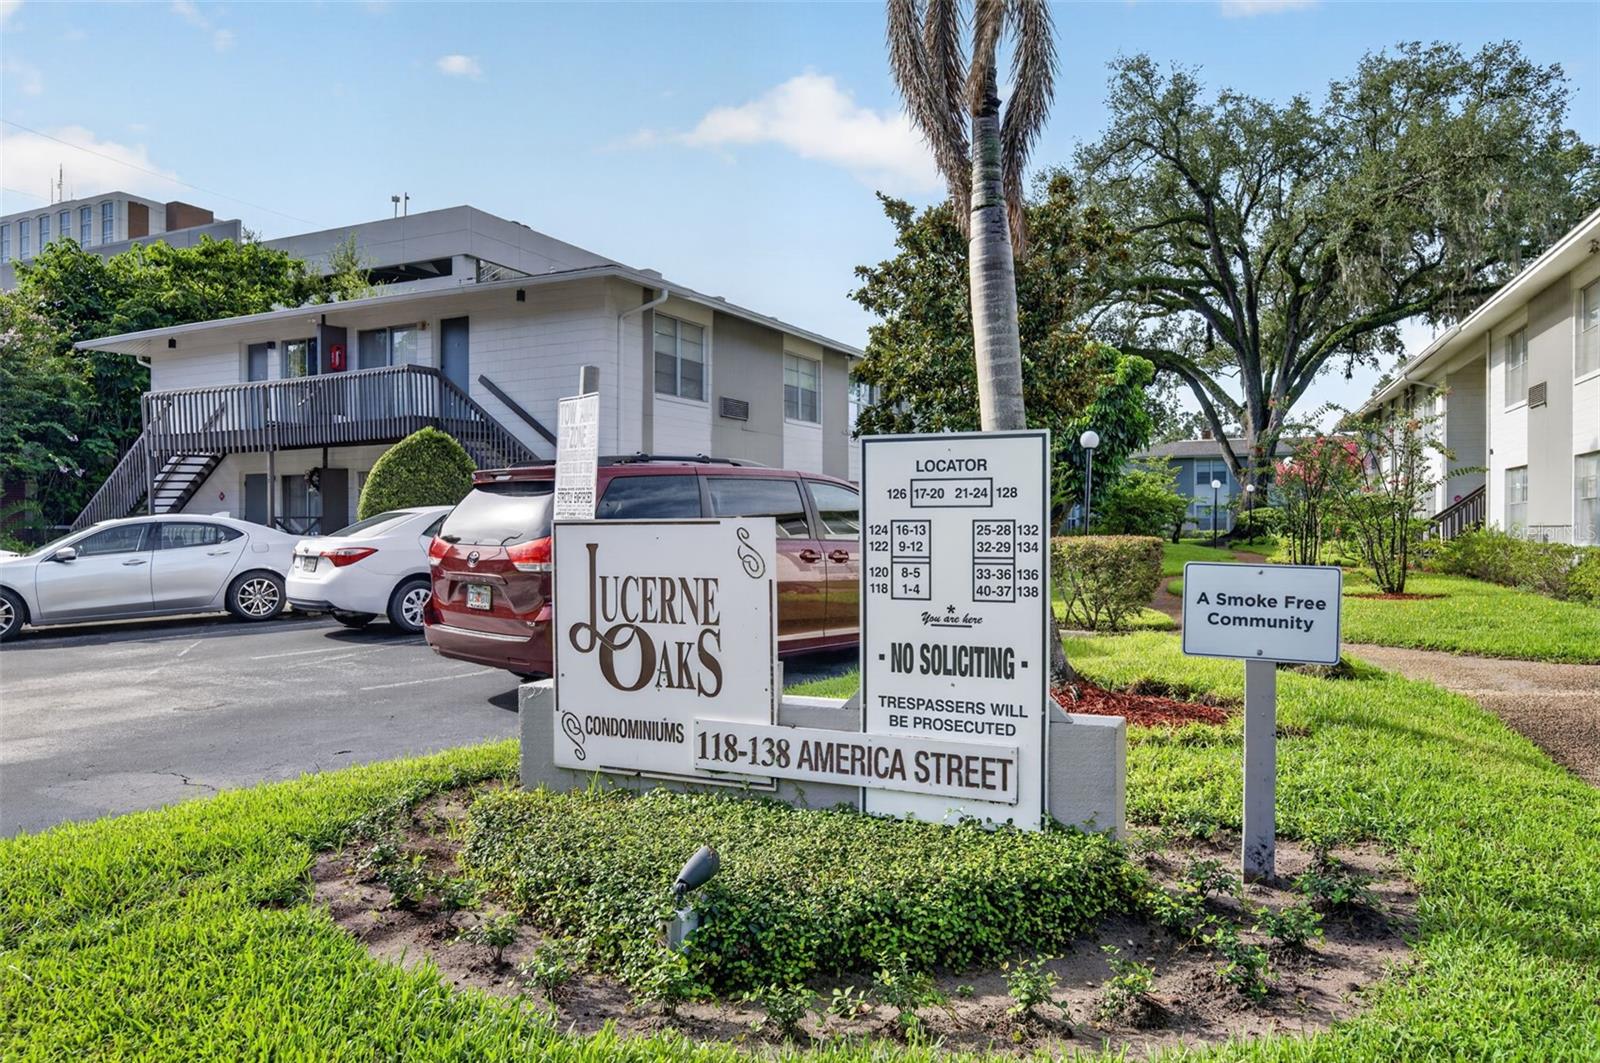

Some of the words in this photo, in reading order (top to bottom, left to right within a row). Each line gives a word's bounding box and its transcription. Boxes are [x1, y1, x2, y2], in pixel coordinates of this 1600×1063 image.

[916, 459, 987, 472] LOCATOR
[887, 489, 907, 499] 126
[914, 489, 944, 499] 17-20
[955, 488, 988, 498] 21-24
[996, 488, 1017, 498] 128
[869, 525, 888, 535] 124
[897, 525, 926, 535] 16-13
[977, 525, 1011, 536] 25-28
[1017, 525, 1038, 536] 132
[869, 541, 888, 552] 122
[899, 542, 923, 552] 9-12
[977, 542, 1011, 553] 32-29
[1017, 542, 1038, 553] 134
[870, 567, 888, 578] 120
[902, 568, 920, 578] 8-5
[976, 569, 1011, 580] 33-36
[1017, 569, 1038, 580] 136
[870, 584, 888, 594] 118
[902, 584, 920, 594] 1-4
[976, 586, 1011, 597] 40-37
[1017, 587, 1038, 597] 138
[569, 543, 720, 653] LUCERNE
[1197, 592, 1210, 605] A
[1216, 593, 1278, 608] Smoke
[1285, 596, 1326, 610] Free
[921, 612, 940, 625] You
[944, 614, 959, 624] are
[962, 613, 983, 624] here
[1207, 612, 1314, 632] Community
[599, 623, 723, 698] OAKS
[891, 642, 913, 673] NO
[920, 643, 1015, 679] SOLICITING
[878, 695, 985, 715] TRESPASSERS
[991, 703, 1028, 718] WILL
[585, 715, 684, 744] CONDOMINIUMS
[889, 715, 908, 728] BE
[913, 716, 1016, 736] PROSECUTED
[697, 731, 790, 769] 118-138
[796, 740, 907, 781] AMERICA
[914, 750, 1014, 792] STREET
